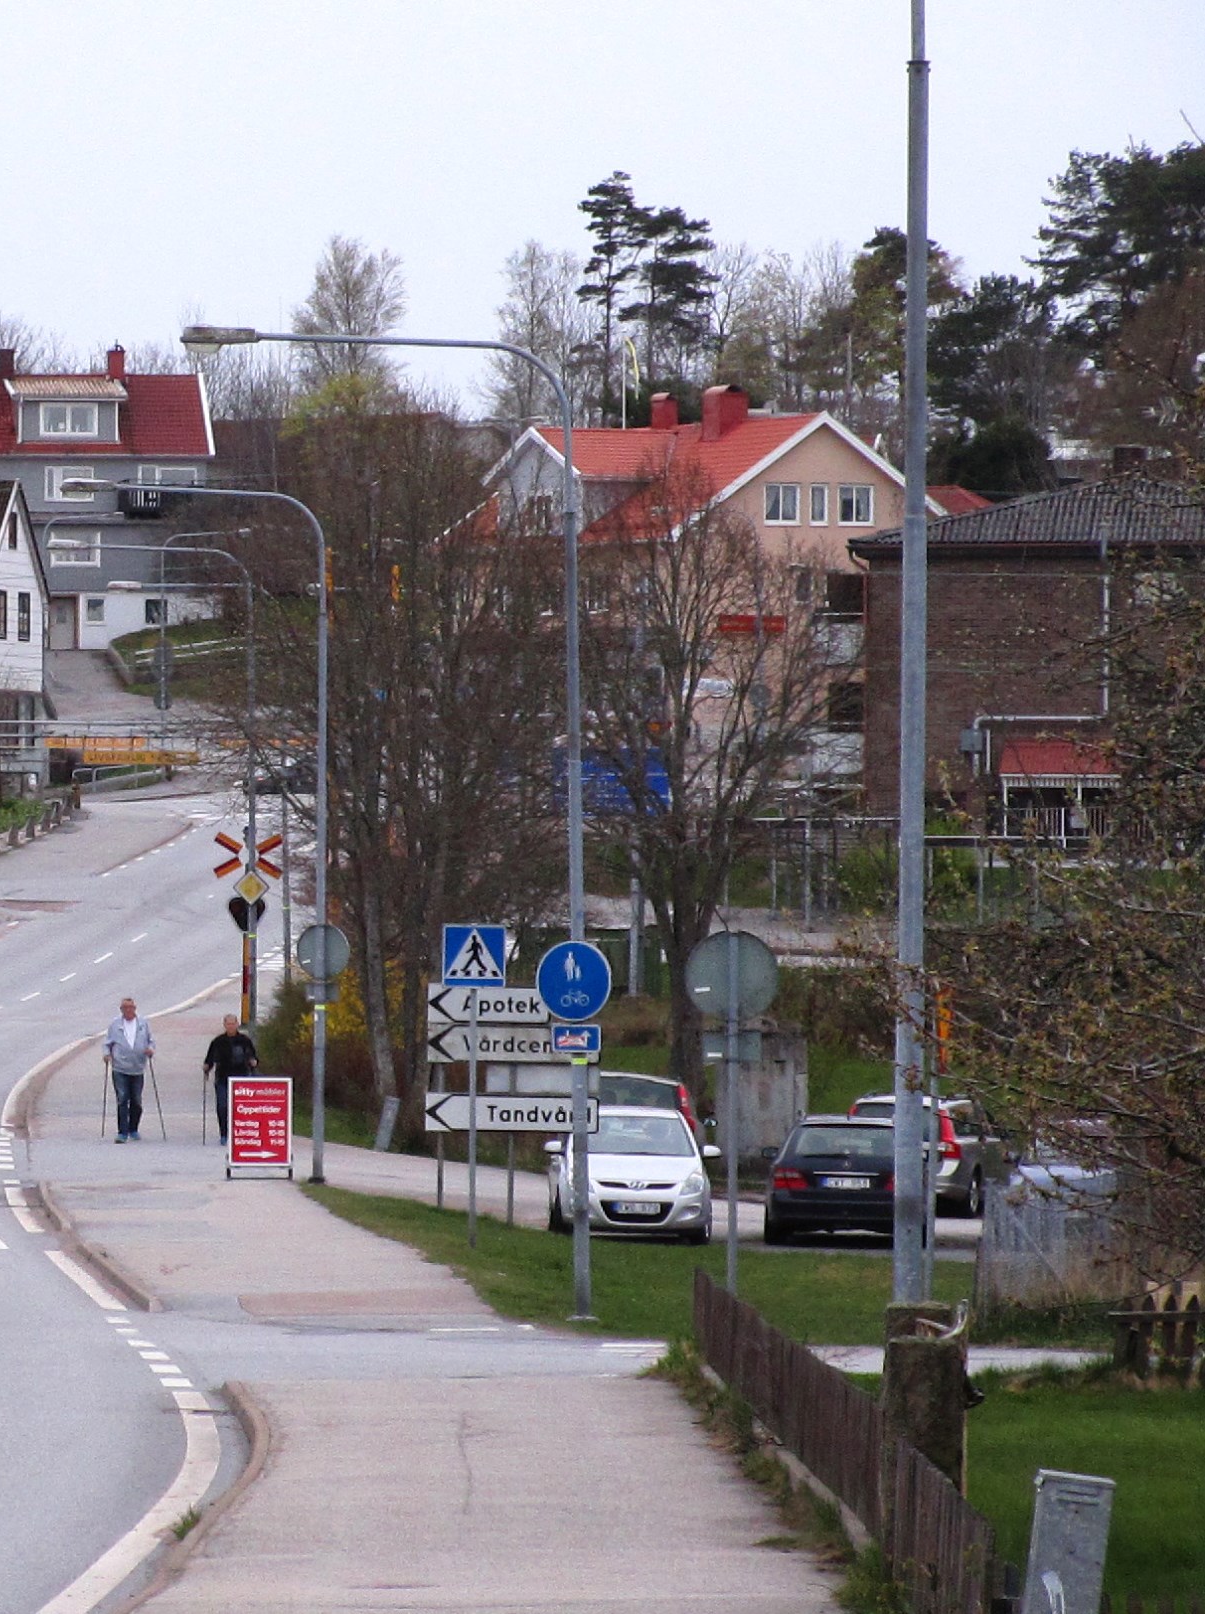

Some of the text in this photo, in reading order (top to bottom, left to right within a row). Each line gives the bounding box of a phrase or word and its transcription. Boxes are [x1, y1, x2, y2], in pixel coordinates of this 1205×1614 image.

[462, 996, 540, 1016] Apotek
[463, 1034, 555, 1053] Vårdcen
[487, 1105, 591, 1123] Tandvå
